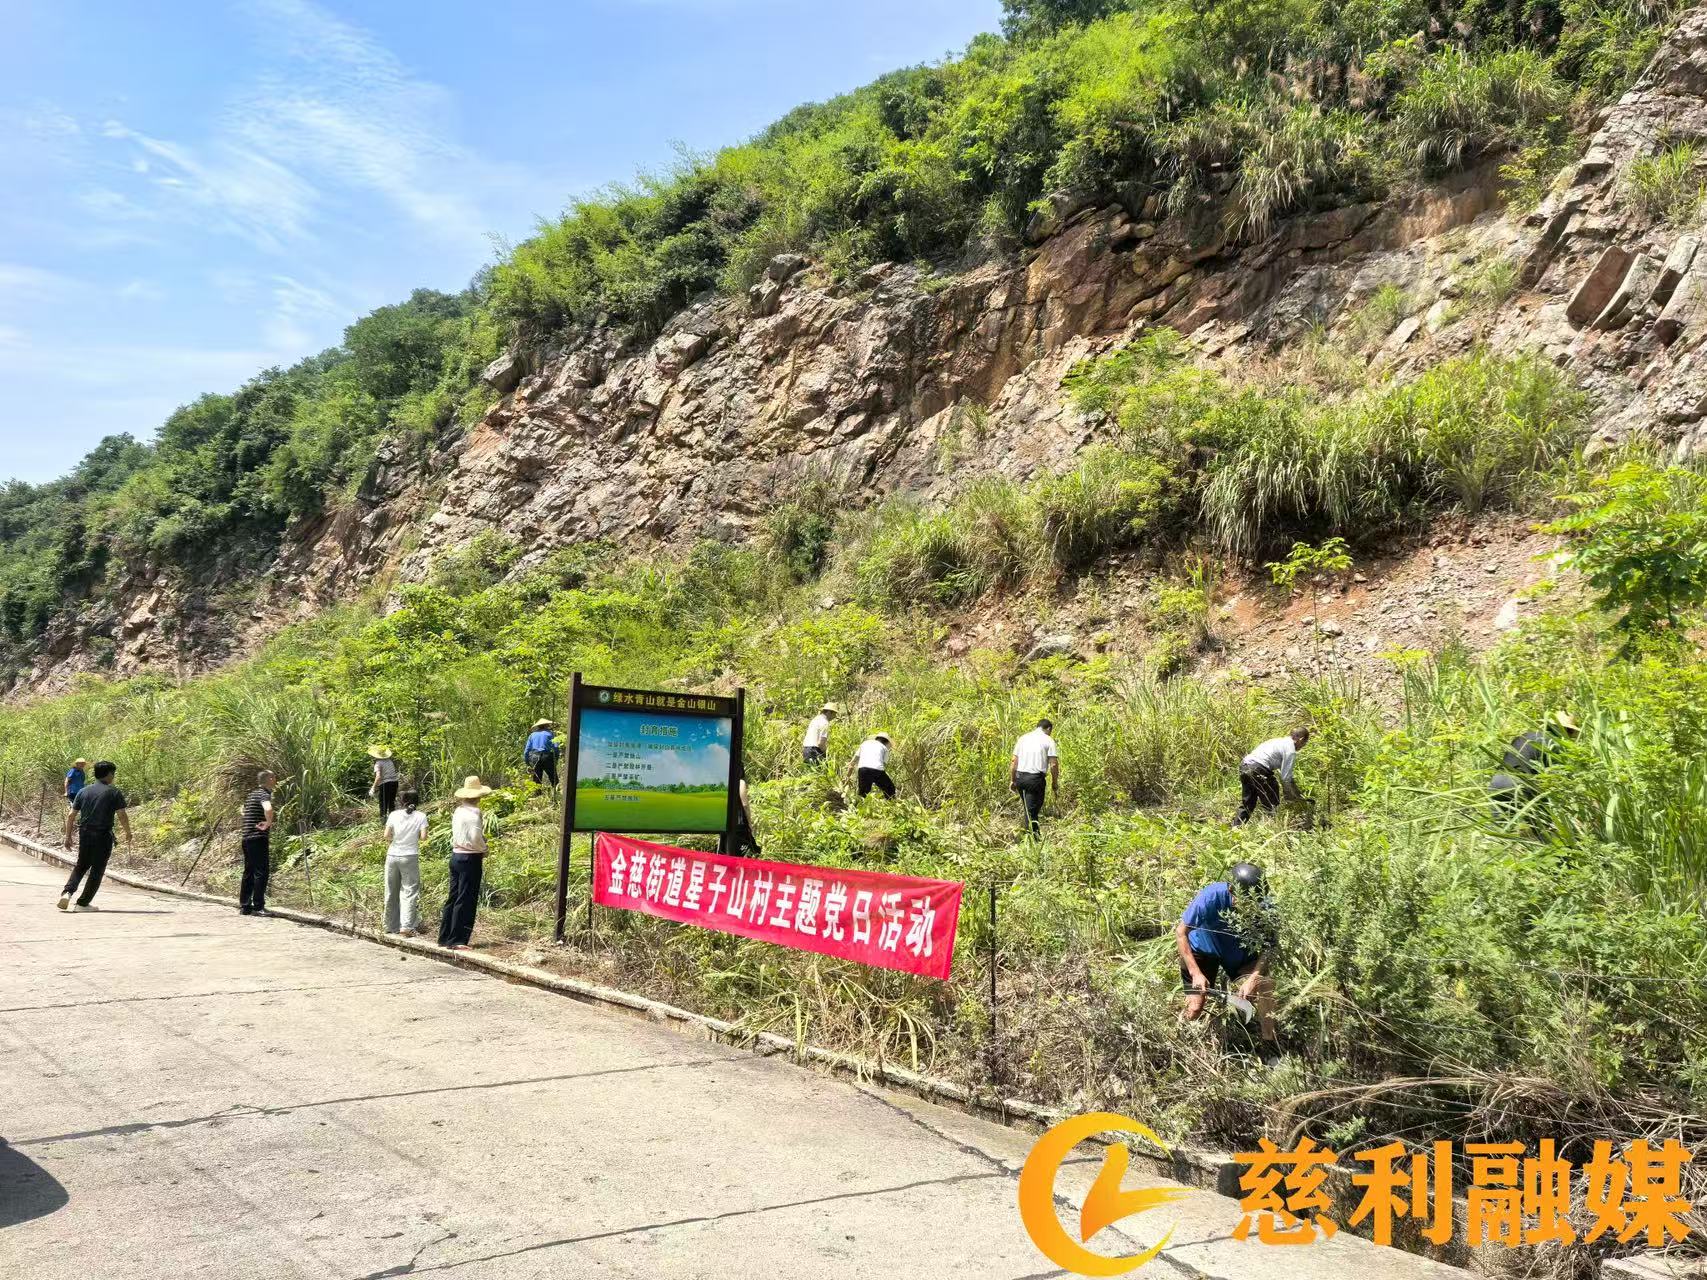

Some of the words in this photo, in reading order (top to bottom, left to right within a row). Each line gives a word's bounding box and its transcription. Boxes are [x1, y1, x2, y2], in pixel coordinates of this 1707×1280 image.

[613, 692, 716, 710] 绿水青山就是金山银山
[608, 848, 936, 957] 金慈街道星子山村主题党日活动
